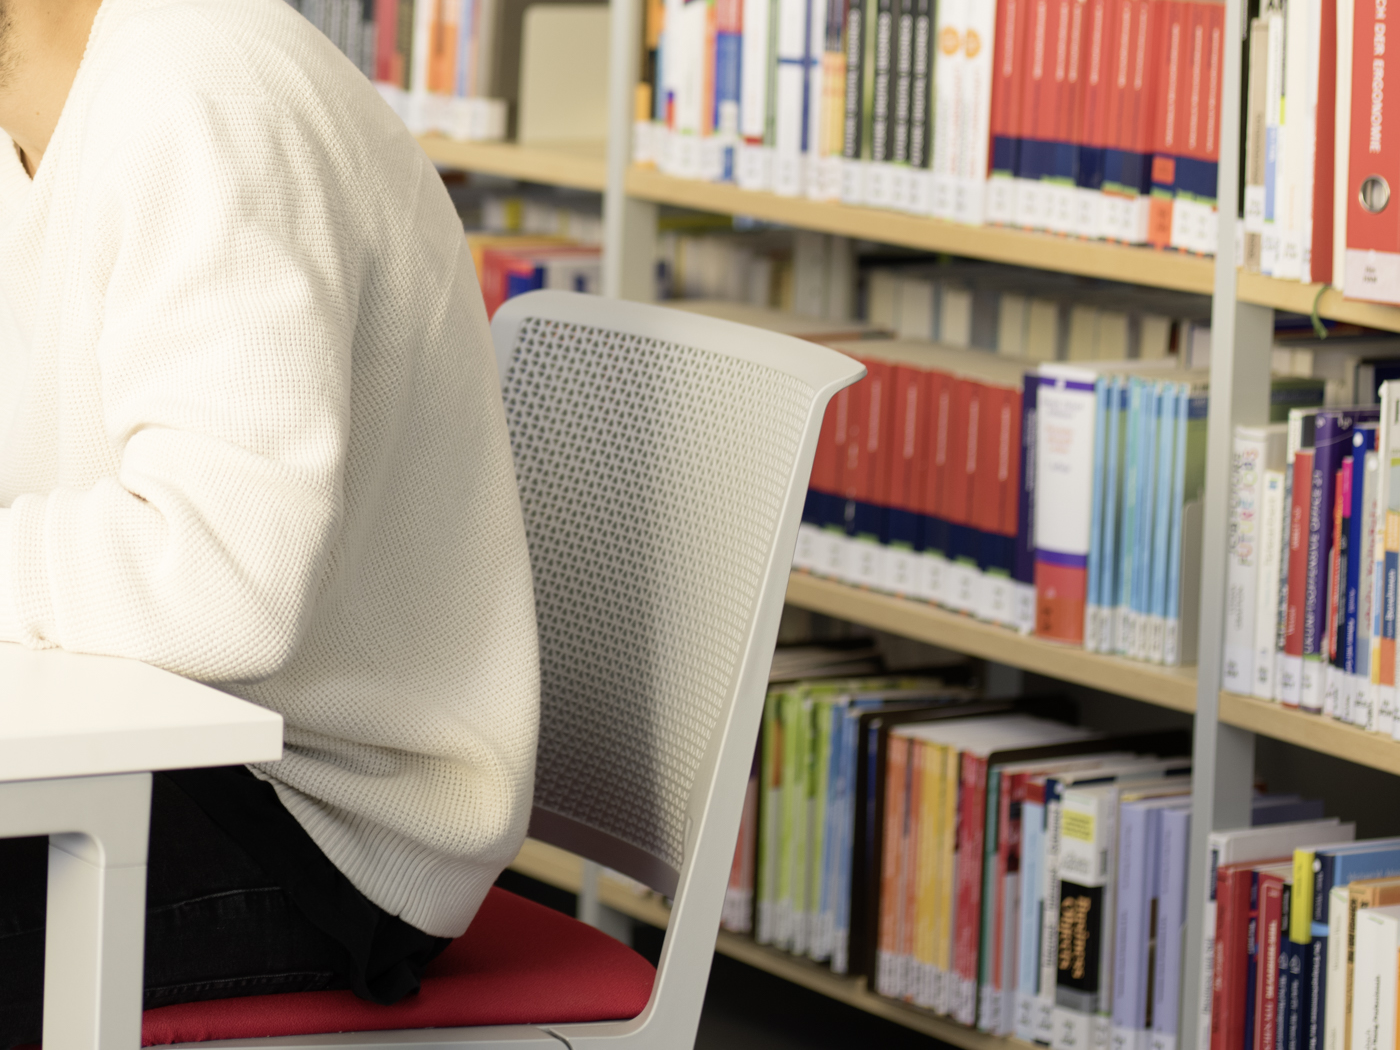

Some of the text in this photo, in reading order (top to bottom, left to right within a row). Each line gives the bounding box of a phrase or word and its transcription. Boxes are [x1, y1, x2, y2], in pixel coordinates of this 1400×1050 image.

[1373, 22, 1387, 57] DER
[1369, 58, 1385, 155] ERGONOMIE
[1304, 533, 1321, 655] UKUNFTSOFFENSIVE
